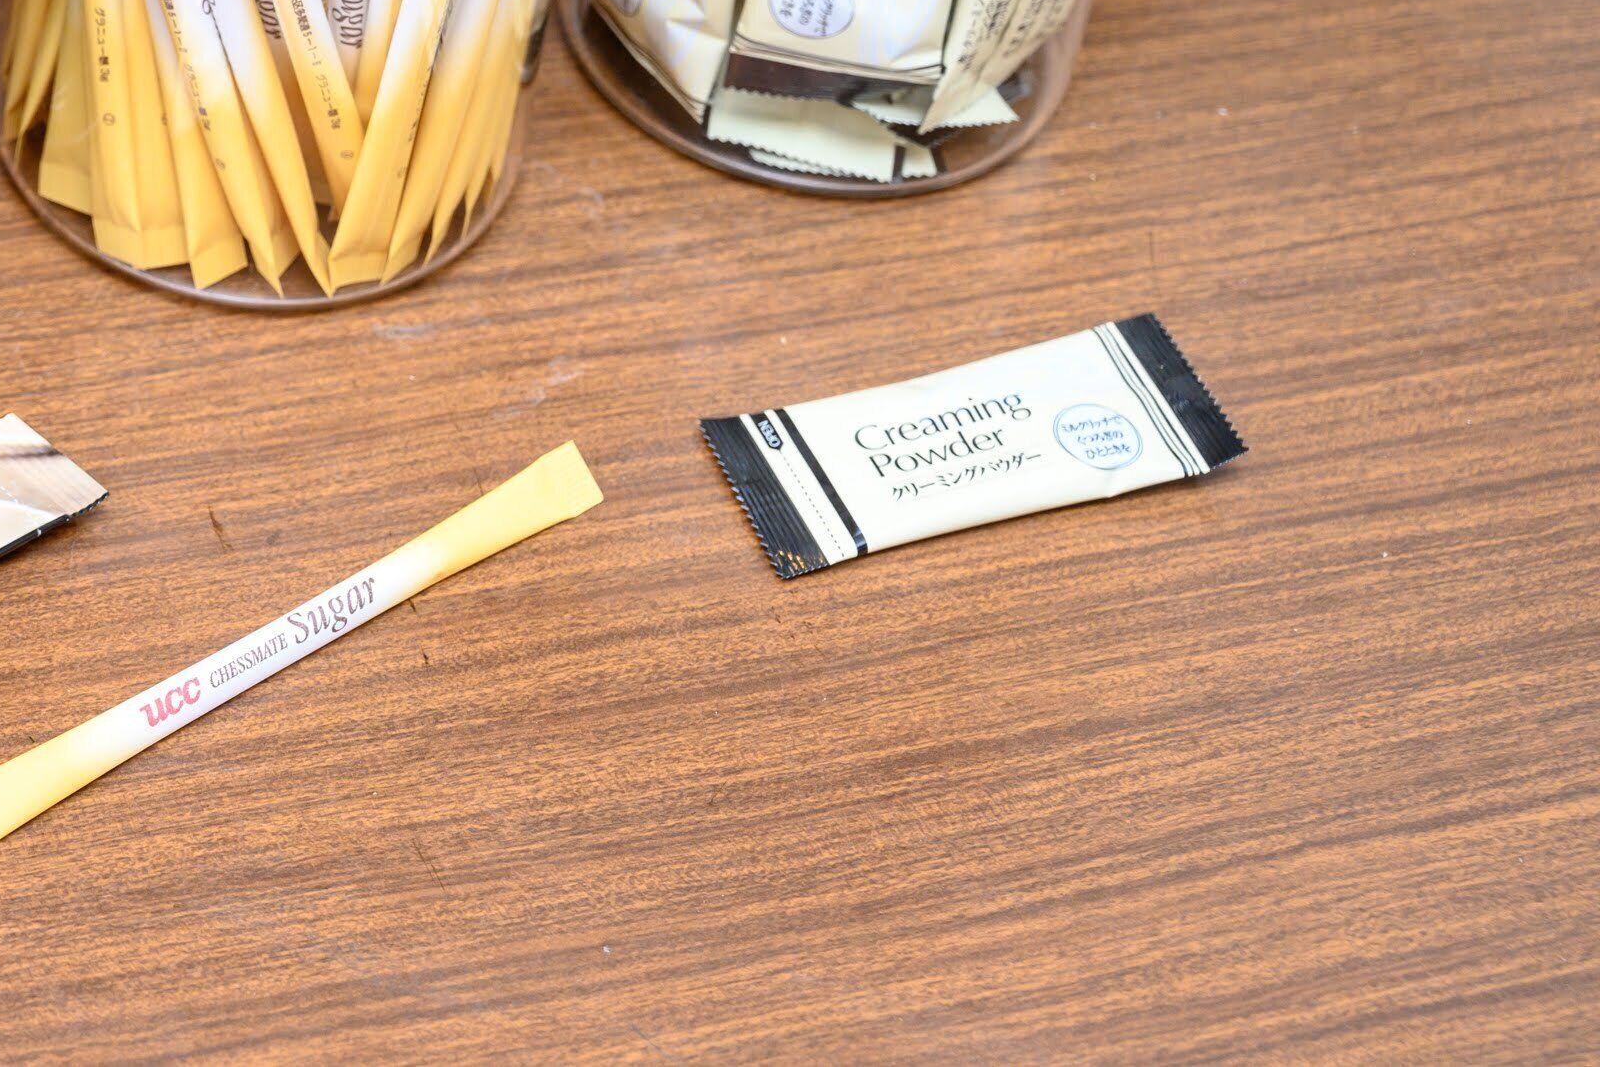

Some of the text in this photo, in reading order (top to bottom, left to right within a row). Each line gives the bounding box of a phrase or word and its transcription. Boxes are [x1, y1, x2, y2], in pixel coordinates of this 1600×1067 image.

[758, 419, 781, 449] OPEN
[852, 390, 1032, 453] Creaming
[869, 424, 1005, 479] Powder
[892, 451, 1042, 501] クリーミングパウダー
[208, 633, 288, 689] CHESSMATE
[286, 575, 378, 644] Sugar
